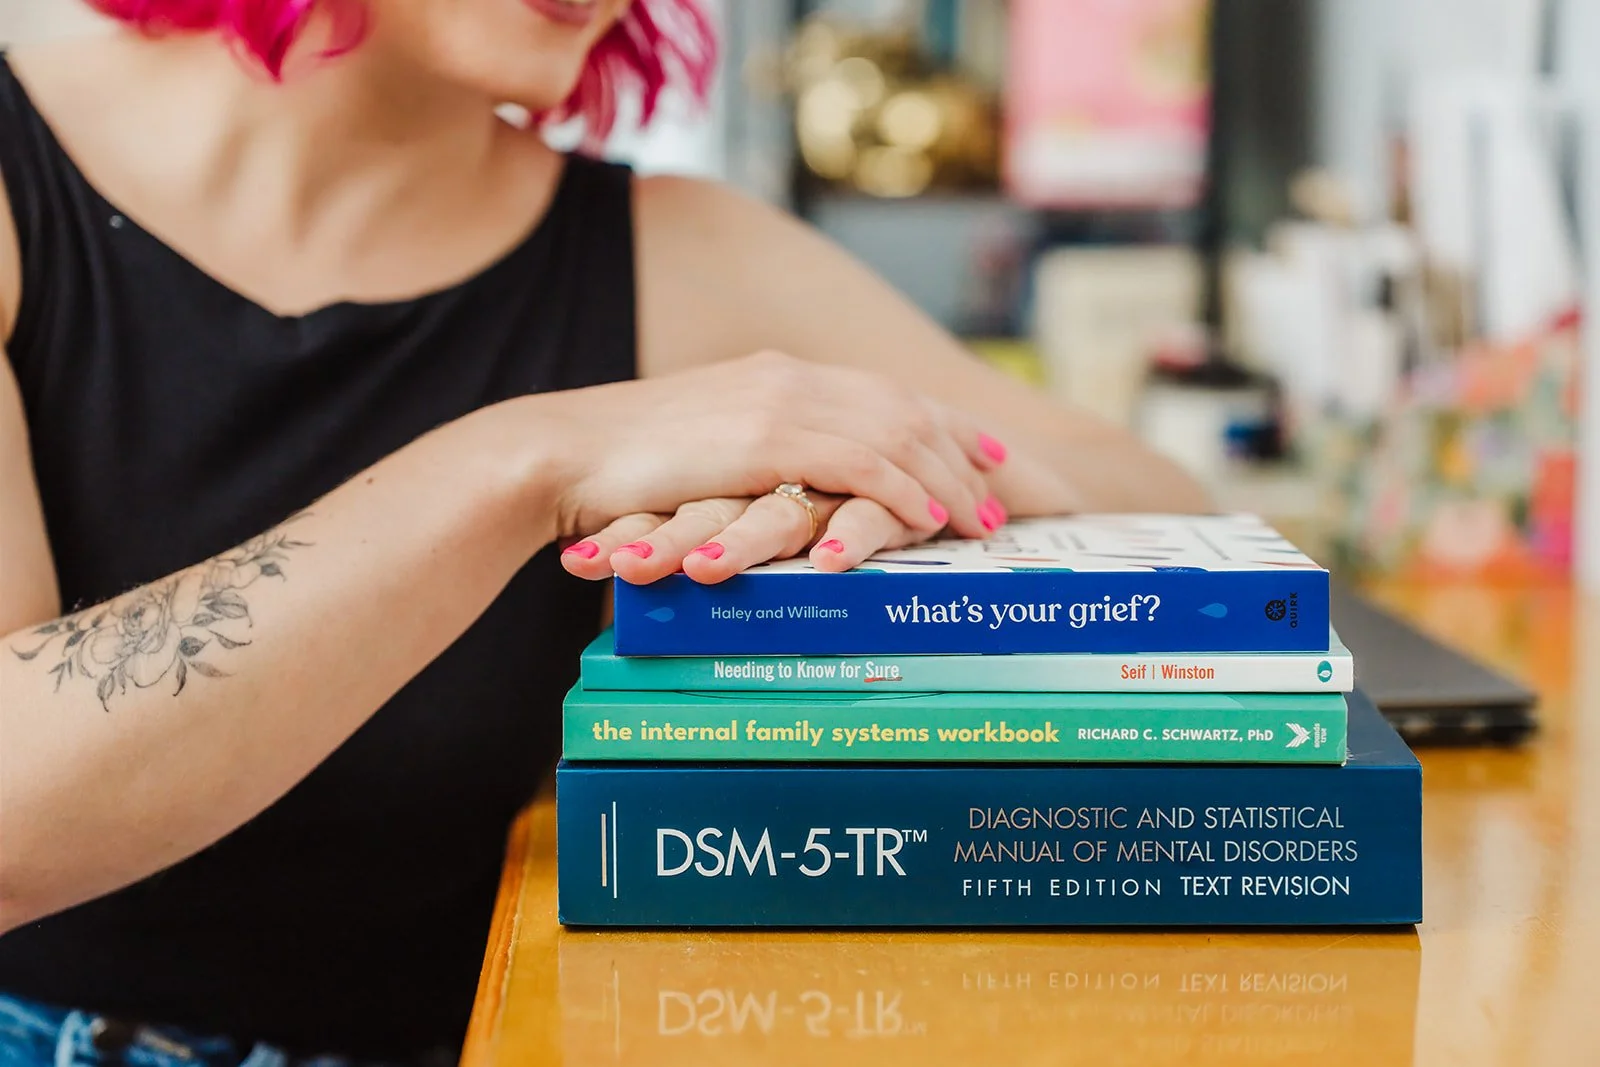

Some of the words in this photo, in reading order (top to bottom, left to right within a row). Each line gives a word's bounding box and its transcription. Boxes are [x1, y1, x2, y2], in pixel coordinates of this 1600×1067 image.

[712, 607, 751, 621] Haley
[756, 606, 783, 618] and
[787, 606, 848, 618] Williams
[885, 596, 983, 622] what’s
[990, 604, 1061, 629] your
[1069, 595, 1160, 628] grief?
[1289, 592, 1298, 628] QUIRK
[714, 661, 774, 681] Needing
[779, 662, 793, 679] to
[797, 661, 836, 679] Know
[840, 661, 861, 679] for
[865, 661, 899, 680] Sure
[1121, 665, 1146, 679] Seif
[1162, 665, 1214, 679] Winston
[593, 720, 632, 740] the
[641, 720, 737, 741] internal
[746, 720, 824, 746] family
[832, 724, 929, 746] systems
[937, 721, 1059, 743] workbook
[1078, 729, 1138, 739] RICHARD
[1143, 729, 1157, 740] C.
[1162, 729, 1243, 742] SCHWARTZ,
[1248, 730, 1273, 740] PhD
[970, 807, 1127, 828] DIAGNOSTIC
[1137, 808, 1194, 828] AND
[1204, 807, 1344, 828] STATISTICAL
[954, 841, 1064, 862] MANUAL
[1073, 841, 1107, 862] OF
[1117, 841, 1215, 861] MENTAL
[1225, 841, 1357, 862] DISORDERS
[964, 880, 1030, 896] FIFTH
[1051, 879, 1160, 896] EDITION
[1180, 877, 1232, 895] TEXT
[1242, 876, 1349, 895] REVISION
